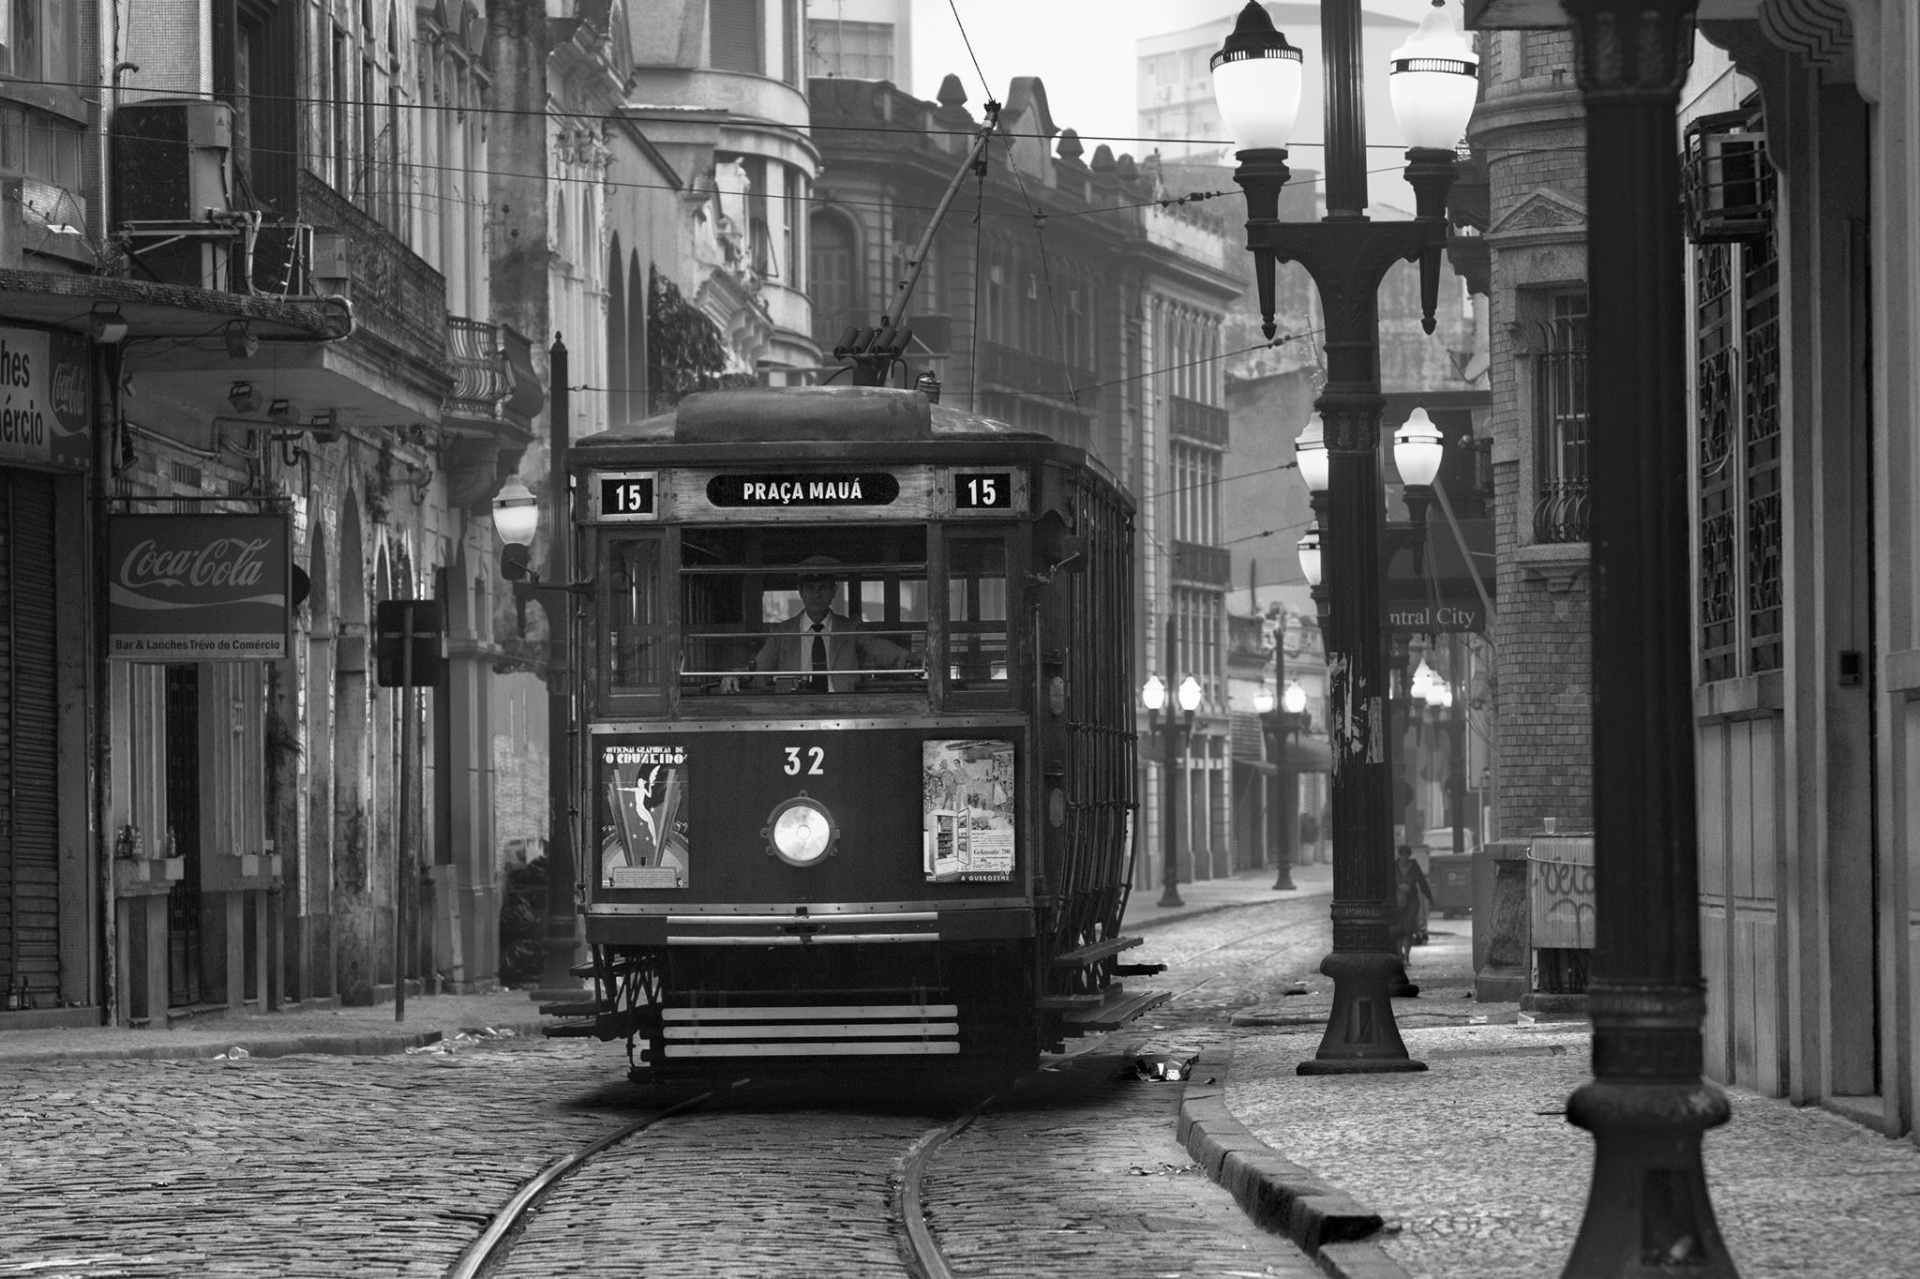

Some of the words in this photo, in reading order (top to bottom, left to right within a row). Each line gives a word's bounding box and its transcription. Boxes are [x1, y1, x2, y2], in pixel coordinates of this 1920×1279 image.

[0, 394, 43, 446] ércio
[616, 484, 641, 511] 15
[743, 482, 804, 504] PRAÇA
[809, 477, 863, 500] MAUÁ
[967, 479, 996, 506] 15
[120, 537, 272, 588] Coca-Cola
[1436, 607, 1475, 629] City
[115, 639, 134, 650] Bar
[135, 639, 145, 650] &
[146, 639, 188, 650] Lanches
[217, 639, 231, 650] do
[232, 638, 280, 650] Comércio
[783, 746, 825, 776] 32
